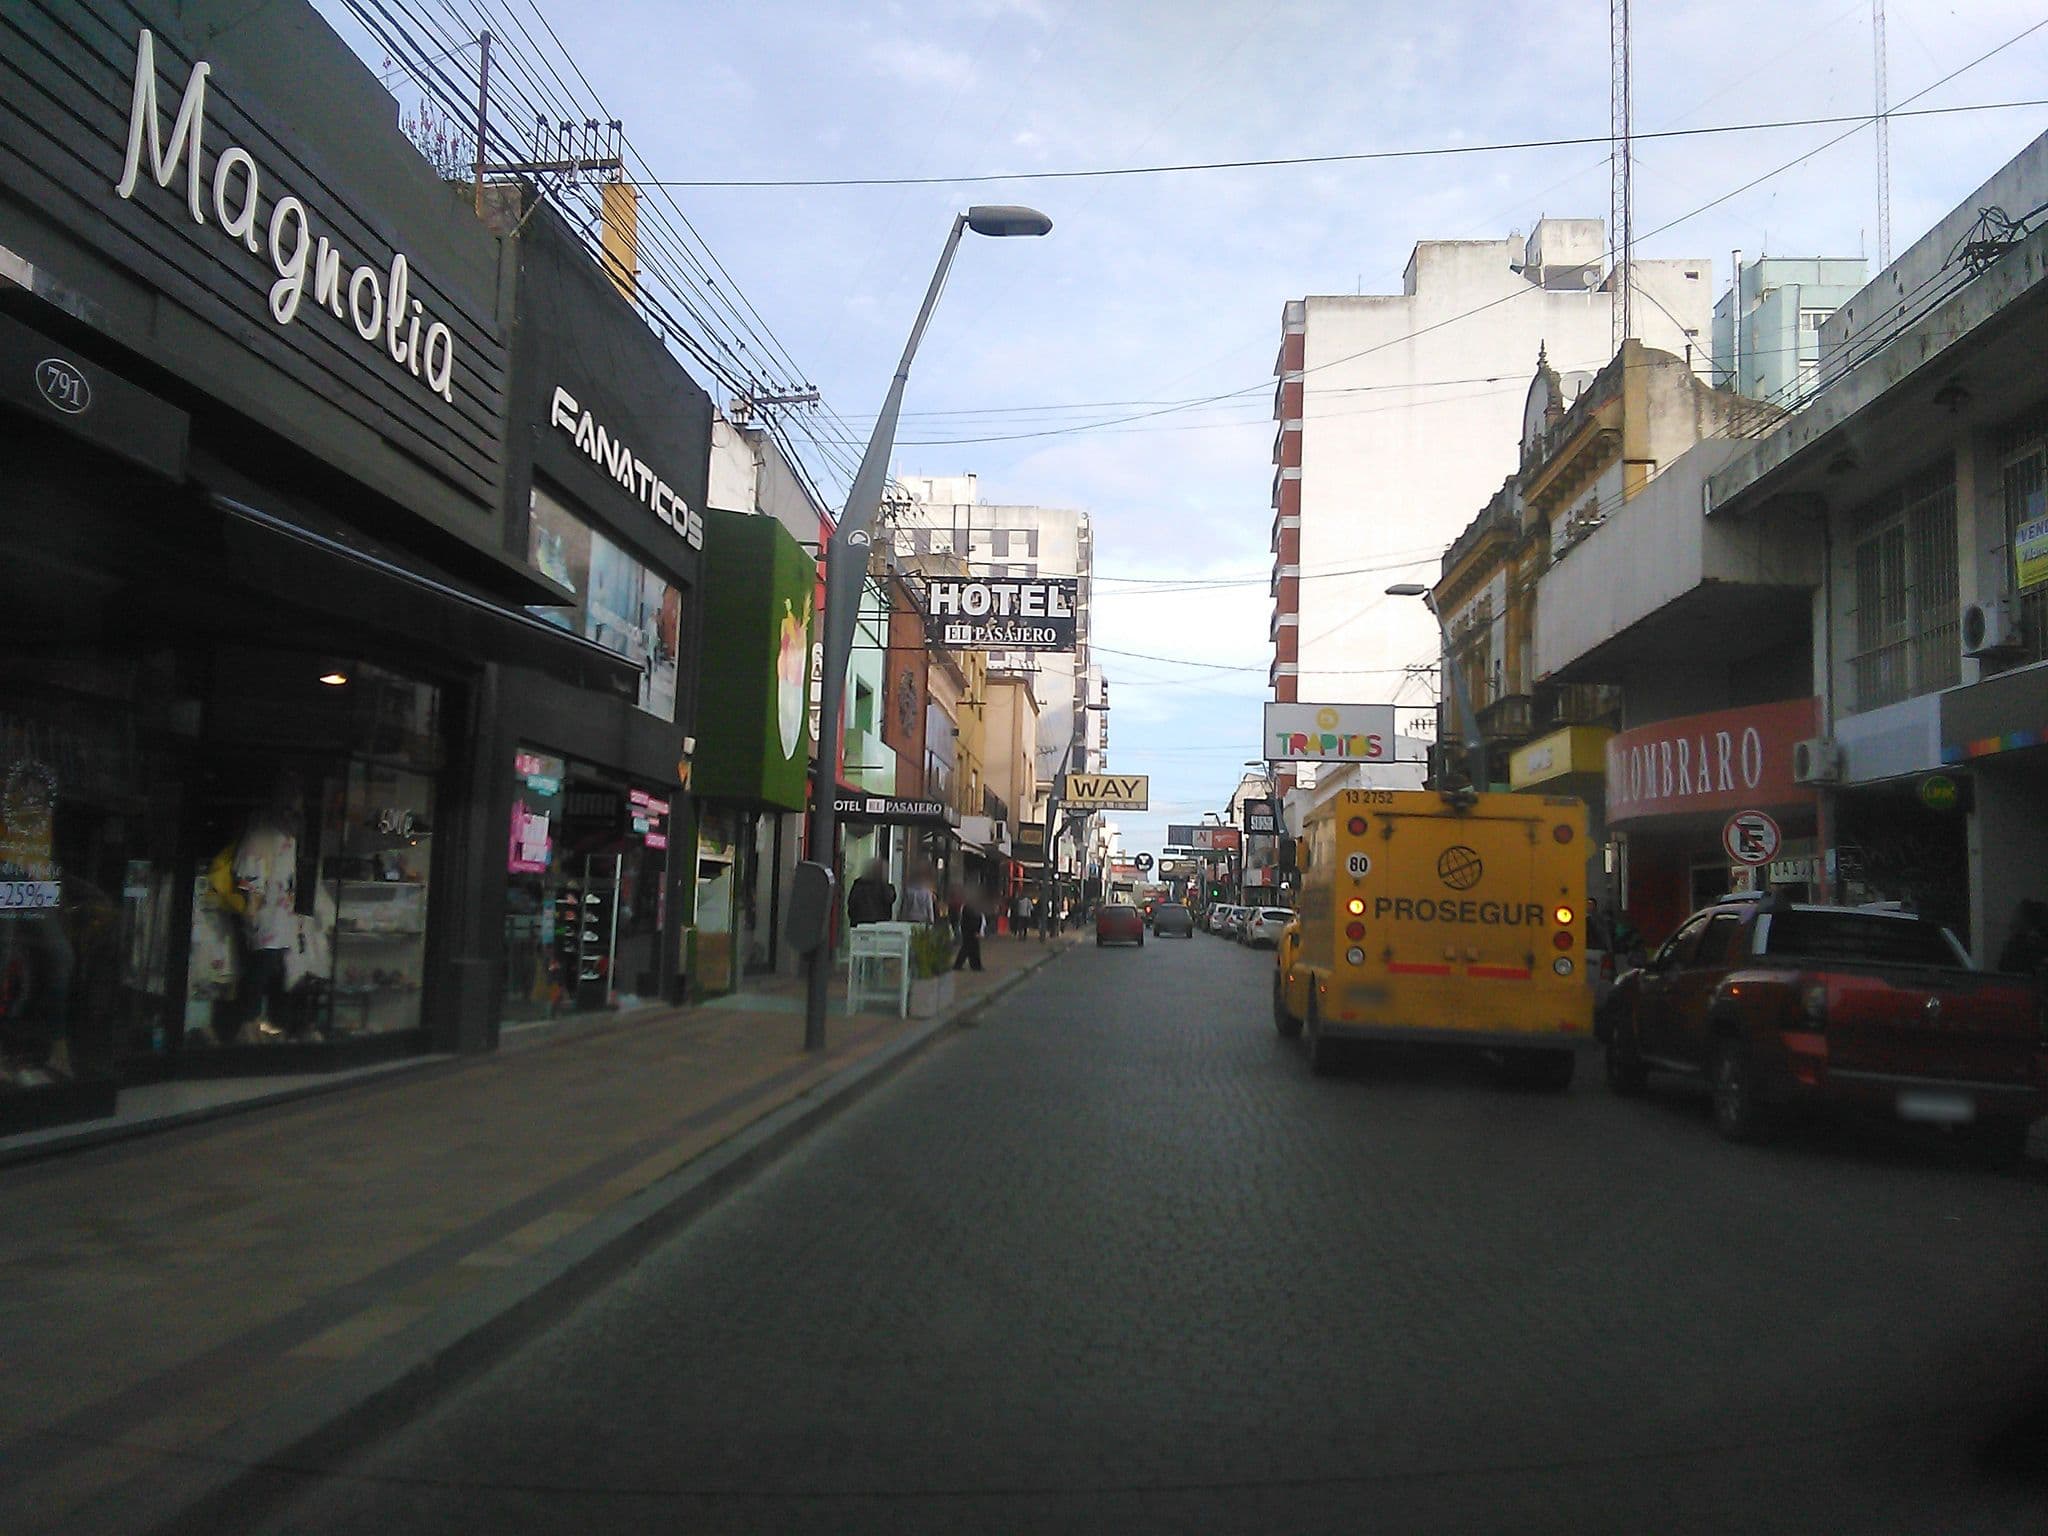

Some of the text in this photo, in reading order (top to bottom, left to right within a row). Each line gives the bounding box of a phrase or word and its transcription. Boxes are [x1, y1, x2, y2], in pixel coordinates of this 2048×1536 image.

[115, 28, 455, 403] Magnolia
[47, 365, 80, 406] 791
[551, 385, 704, 552] FANATICOS
[929, 582, 1072, 618] HOTEL
[948, 626, 1057, 643] EL PASAJERO
[1276, 732, 1383, 758] TRAPITOS
[1072, 778, 1140, 799] WAY
[1345, 790, 1393, 805] 13 2752
[833, 799, 862, 812] OTEL
[886, 801, 942, 815] PASAJERO
[1349, 856, 1368, 873] 80
[1374, 897, 1546, 927] PROSEGUR
